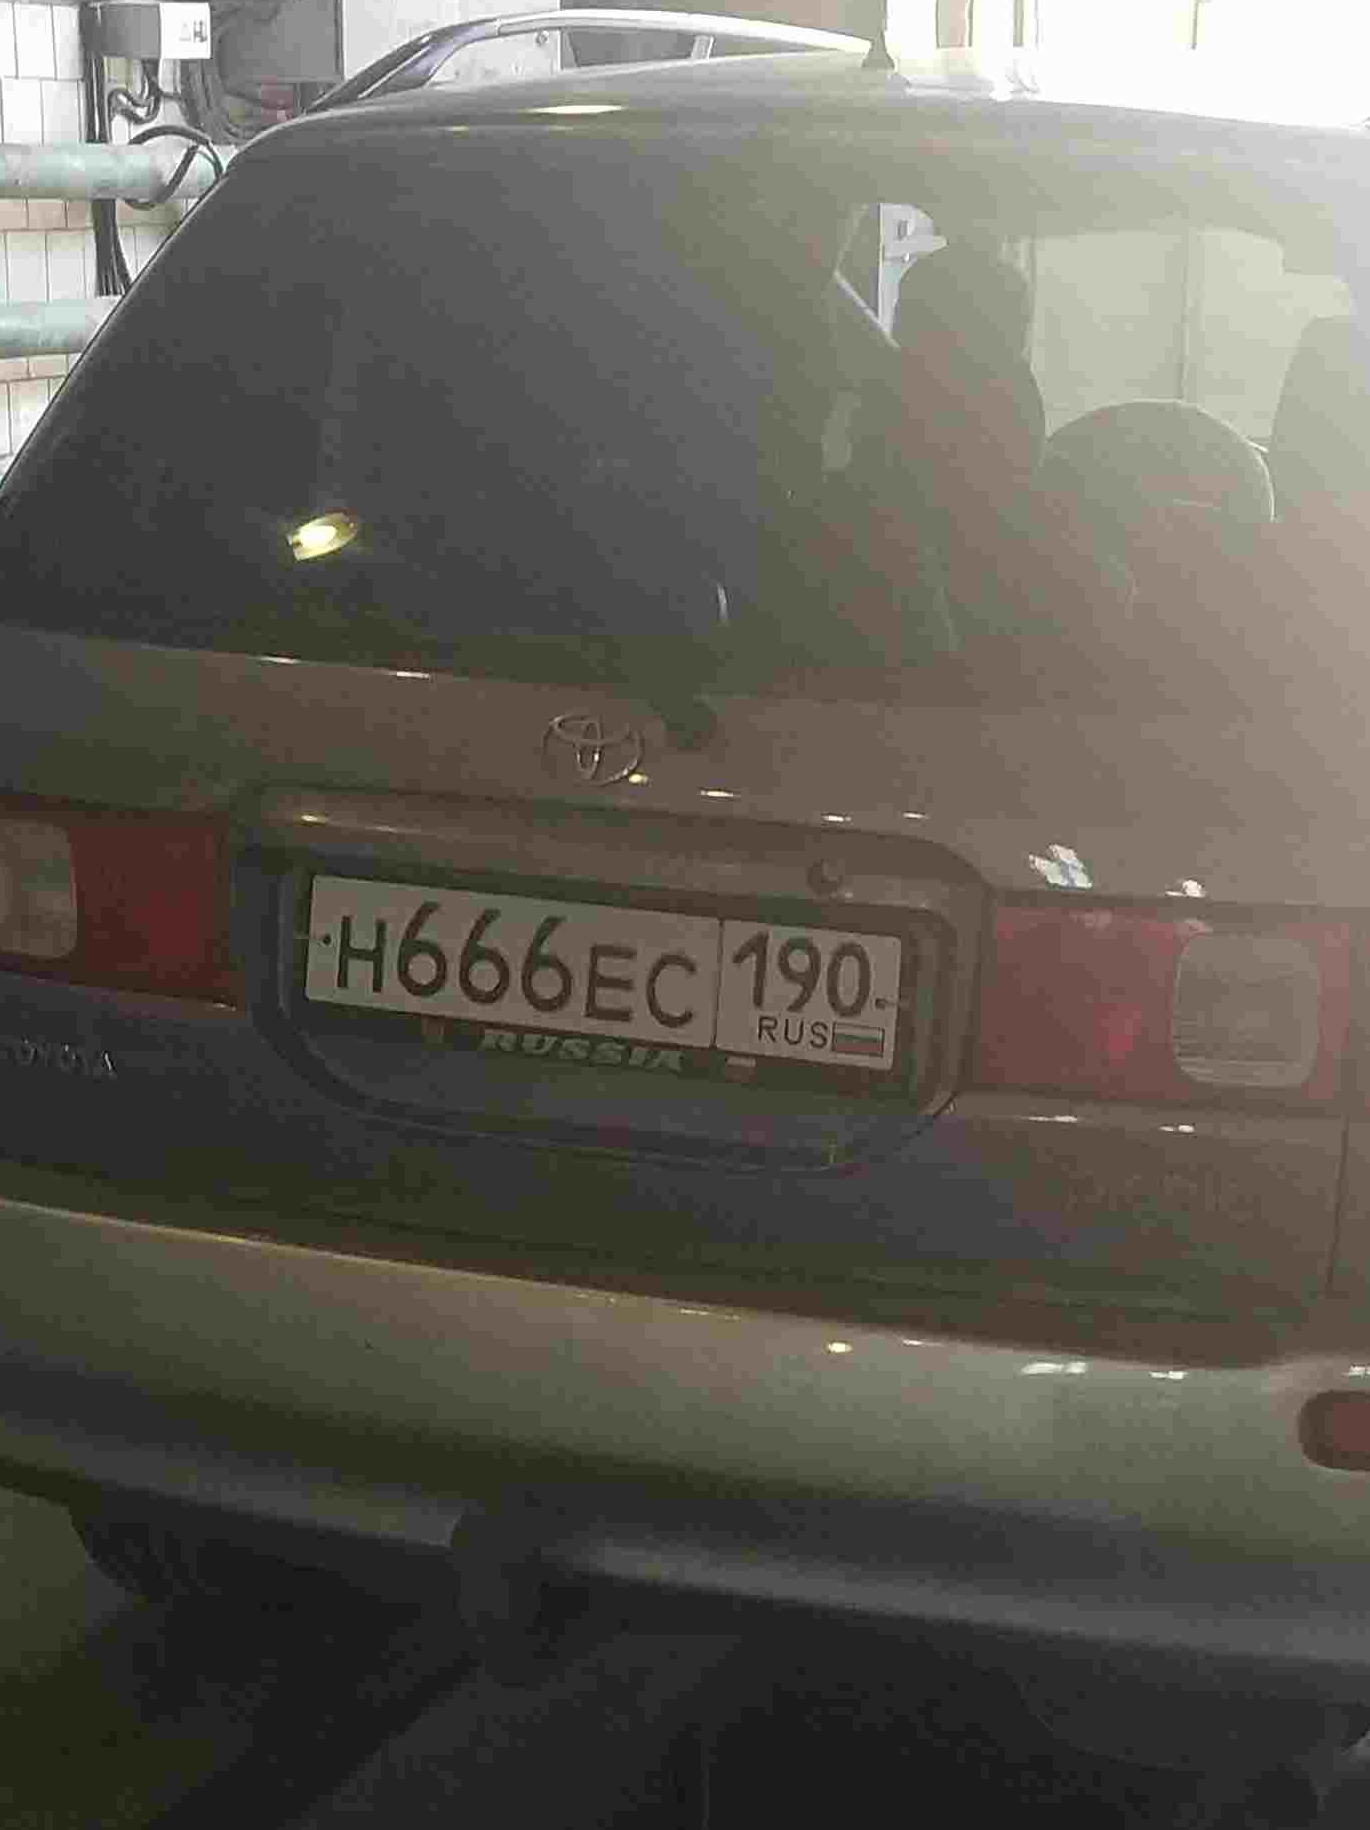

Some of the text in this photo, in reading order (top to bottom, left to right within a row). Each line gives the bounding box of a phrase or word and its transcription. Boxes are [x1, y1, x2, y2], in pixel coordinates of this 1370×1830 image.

[336, 901, 698, 1028] H666EC
[732, 931, 871, 1017] 190
[758, 1015, 828, 1049] RUS
